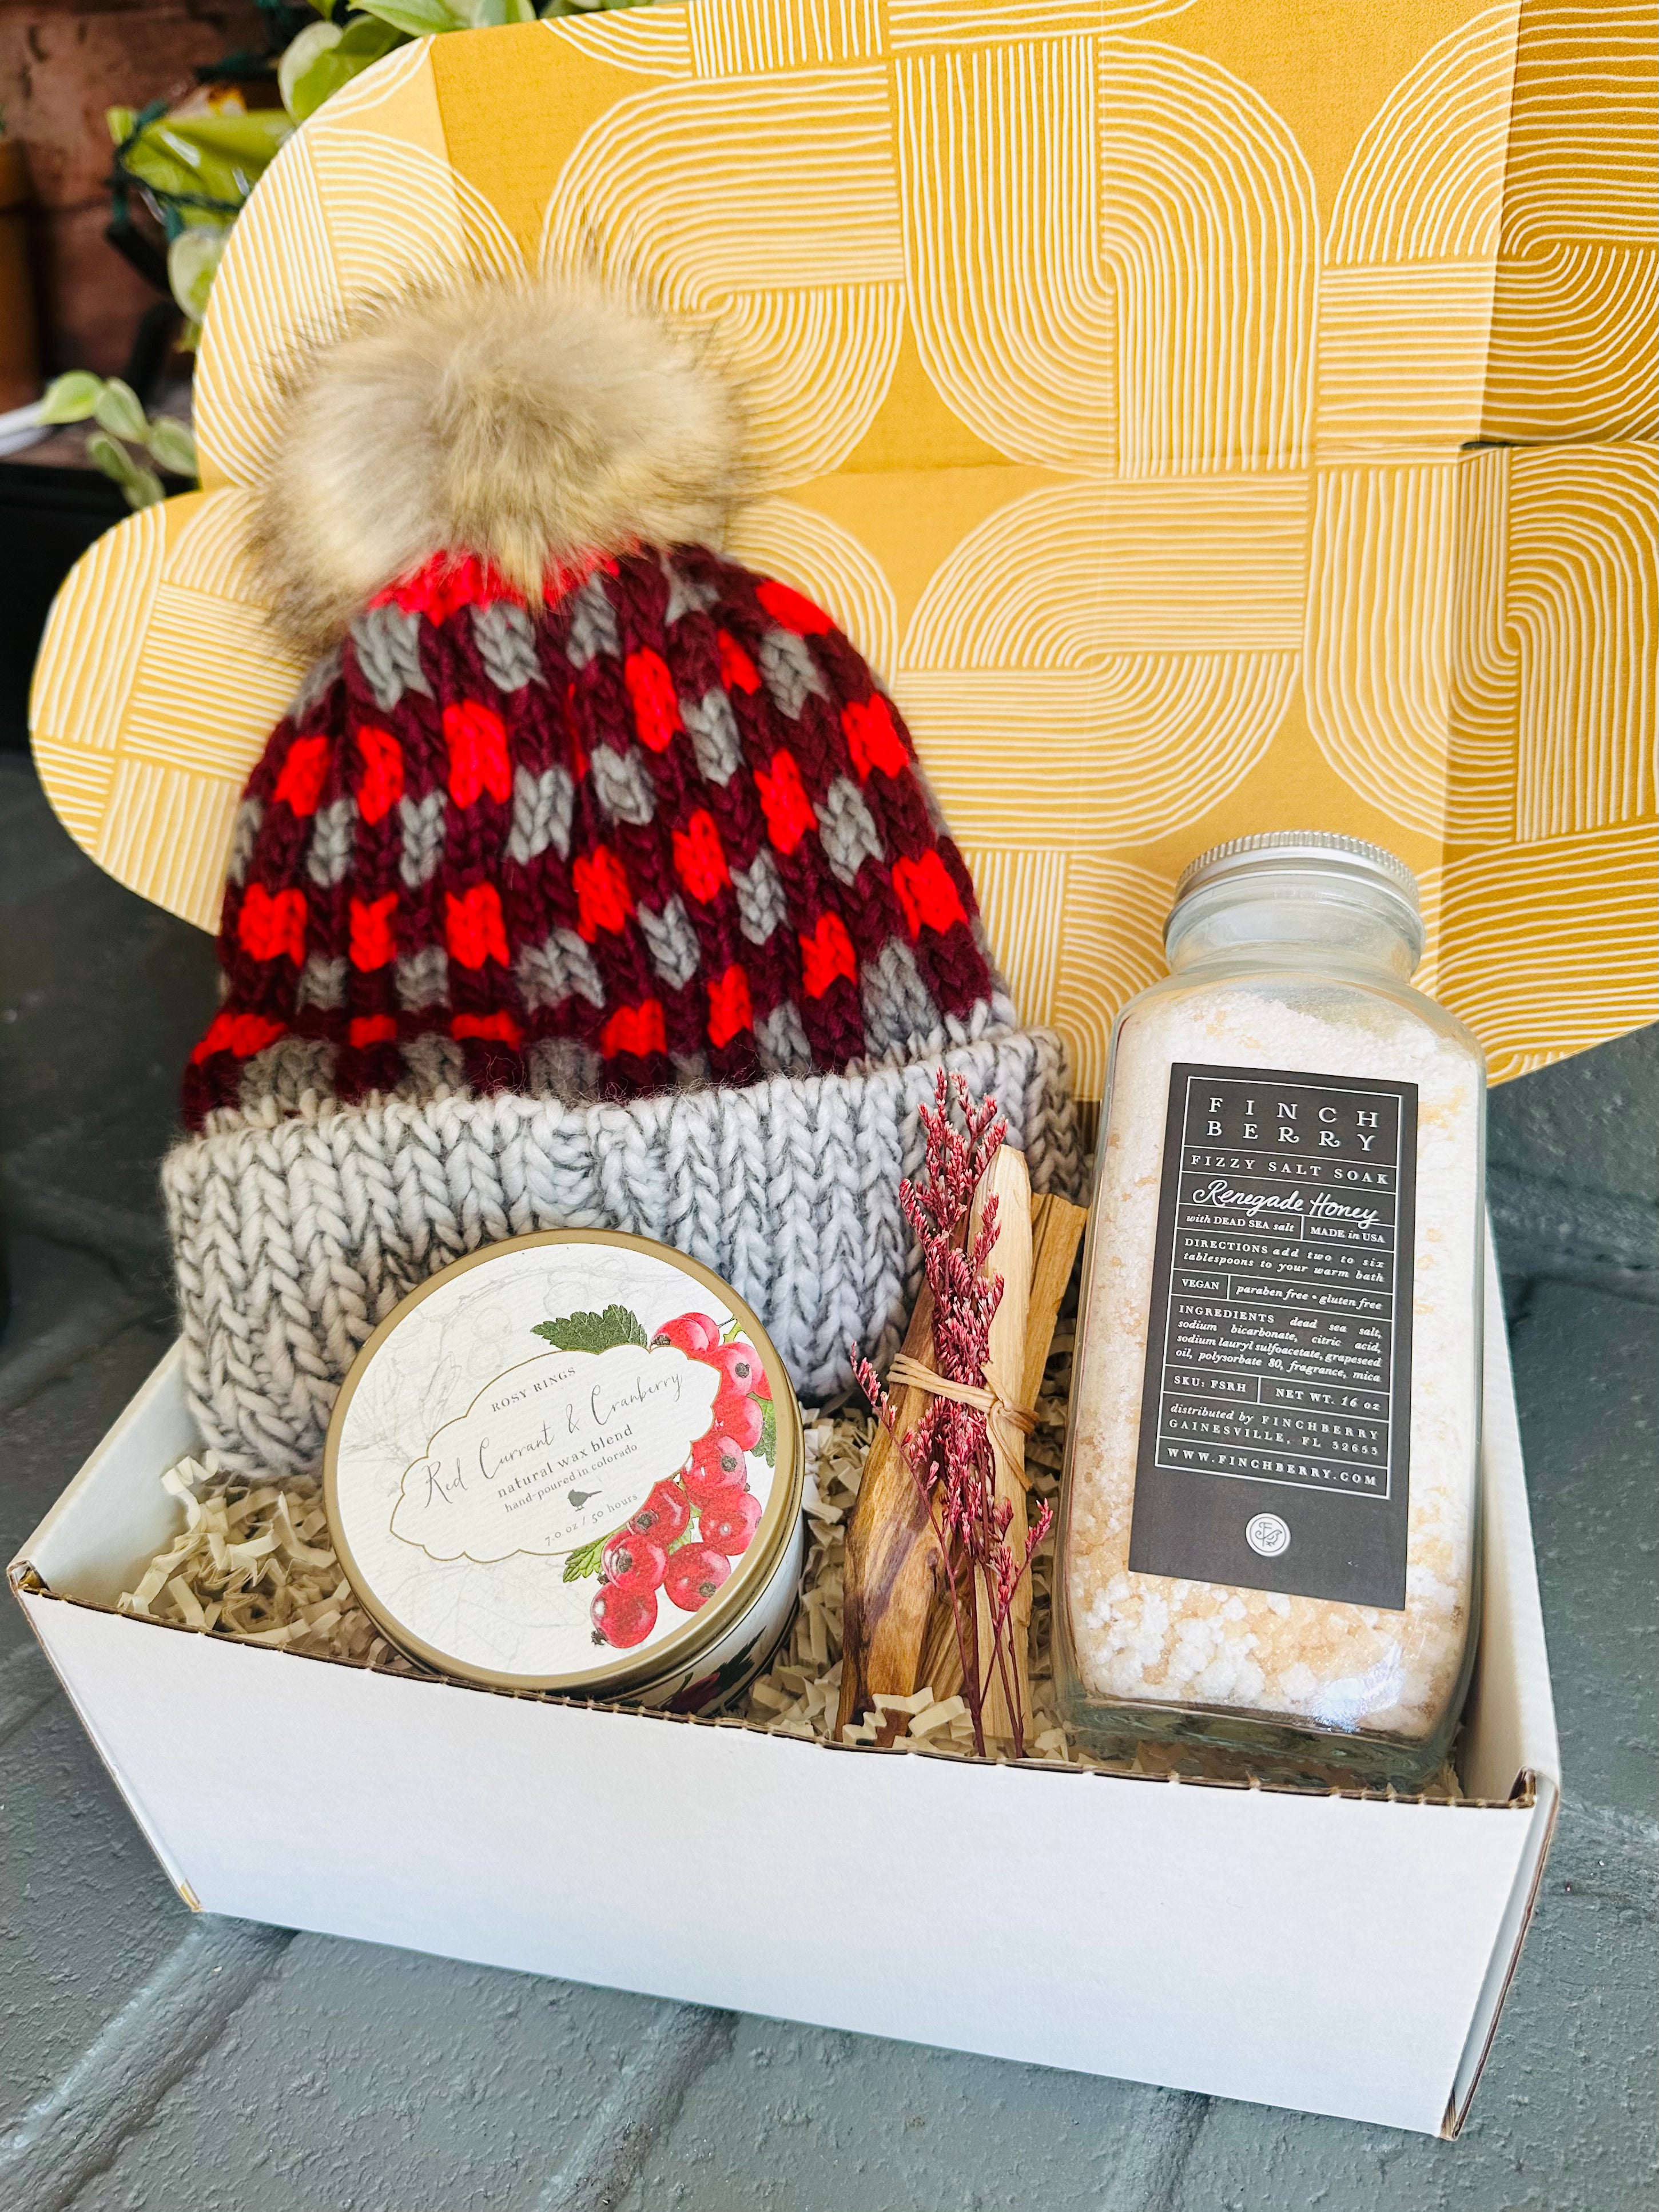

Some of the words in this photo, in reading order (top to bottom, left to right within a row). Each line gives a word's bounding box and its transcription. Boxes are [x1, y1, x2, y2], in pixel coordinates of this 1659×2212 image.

[1208, 1097, 1379, 1128] FINCH
[1207, 1120, 1375, 1152] BERRY
[1191, 1155, 1256, 1171] FIZZY
[1268, 1161, 1322, 1177] SALT
[1334, 1168, 1389, 1185] SOAK
[1192, 1179, 1304, 1217] Renegade
[1310, 1192, 1380, 1230] Honey
[1186, 1213, 1211, 1224] with
[1213, 1216, 1246, 1228] DEAD
[1248, 1220, 1270, 1230] SEA
[1273, 1222, 1295, 1233] salt
[1310, 1226, 1345, 1239] MADE
[1348, 1230, 1360, 1240] in
[1362, 1232, 1386, 1244] USA
[1183, 1252, 1254, 1271] tablespoons
[1260, 1260, 1272, 1270] to
[1276, 1263, 1309, 1274] your
[1314, 1267, 1349, 1278] warm
[1355, 1269, 1384, 1282] bath
[1184, 1238, 1268, 1254] DIRECTIONS
[1272, 1246, 1299, 1258] add
[1307, 1251, 1331, 1262] two
[1341, 1254, 1354, 1264] to
[1363, 1258, 1386, 1268] six
[1181, 1279, 1219, 1290] VEGAN
[1236, 1284, 1283, 1298] paraben
[1283, 1288, 1308, 1301] free
[1319, 1292, 1358, 1306] gluten
[1355, 1296, 1382, 1311] free
[1177, 1319, 1218, 1331] sodium
[1231, 1324, 1298, 1342] bicarbonate,
[1311, 1335, 1342, 1347] citric
[1354, 1340, 1382, 1354] acid,
[1179, 1305, 1275, 1323] INGREDIENTS
[1290, 1317, 1318, 1328] dead
[1328, 1324, 1347, 1332] sea
[1358, 1326, 1383, 1338] salt,
[1175, 1348, 1193, 1359] oil,
[1198, 1351, 1262, 1367] polysorbate
[1268, 1358, 1284, 1371] 80,
[1286, 1360, 1346, 1379] fragrance,
[1352, 1371, 1380, 1382] mica
[1176, 1334, 1216, 1346] sodium
[1218, 1338, 1254, 1351] lauryl
[1255, 1343, 1323, 1360] sulfoacetate,
[1324, 1352, 1382, 1367] grapeseed
[492, 1390, 527, 1412] ROSY
[534, 1367, 576, 1393] RINGS
[1173, 1375, 1204, 1387] SKU:
[1211, 1380, 1246, 1393] FSRH
[1275, 1388, 1304, 1400] NET
[1310, 1392, 1334, 1404] WT.
[1340, 1395, 1358, 1407] 16
[1363, 1402, 1380, 1411] oz
[1170, 1403, 1234, 1421] distributed
[1239, 1411, 1254, 1425] by
[1262, 1415, 1378, 1440] FINCHBERRY
[421, 1458, 469, 1509] Red
[479, 1421, 555, 1479] Currant
[565, 1404, 579, 1433] &
[591, 1373, 683, 1426] Cranberry
[1302, 1437, 1321, 1447] FL
[1332, 1441, 1379, 1456] 32653
[498, 1466, 553, 1498] natural
[556, 1449, 588, 1469] wax
[591, 1425, 633, 1453] blend
[1167, 1448, 1377, 1486] WWW.FINCHBERRY.COM
[504, 1475, 577, 1513] hand-poured
[578, 1467, 590, 1479] in
[591, 1443, 638, 1471] colorado
[545, 1531, 563, 1545] 7.0
[566, 1523, 579, 1535] oz
[592, 1510, 604, 1524] 50
[608, 1493, 638, 1513] hours
